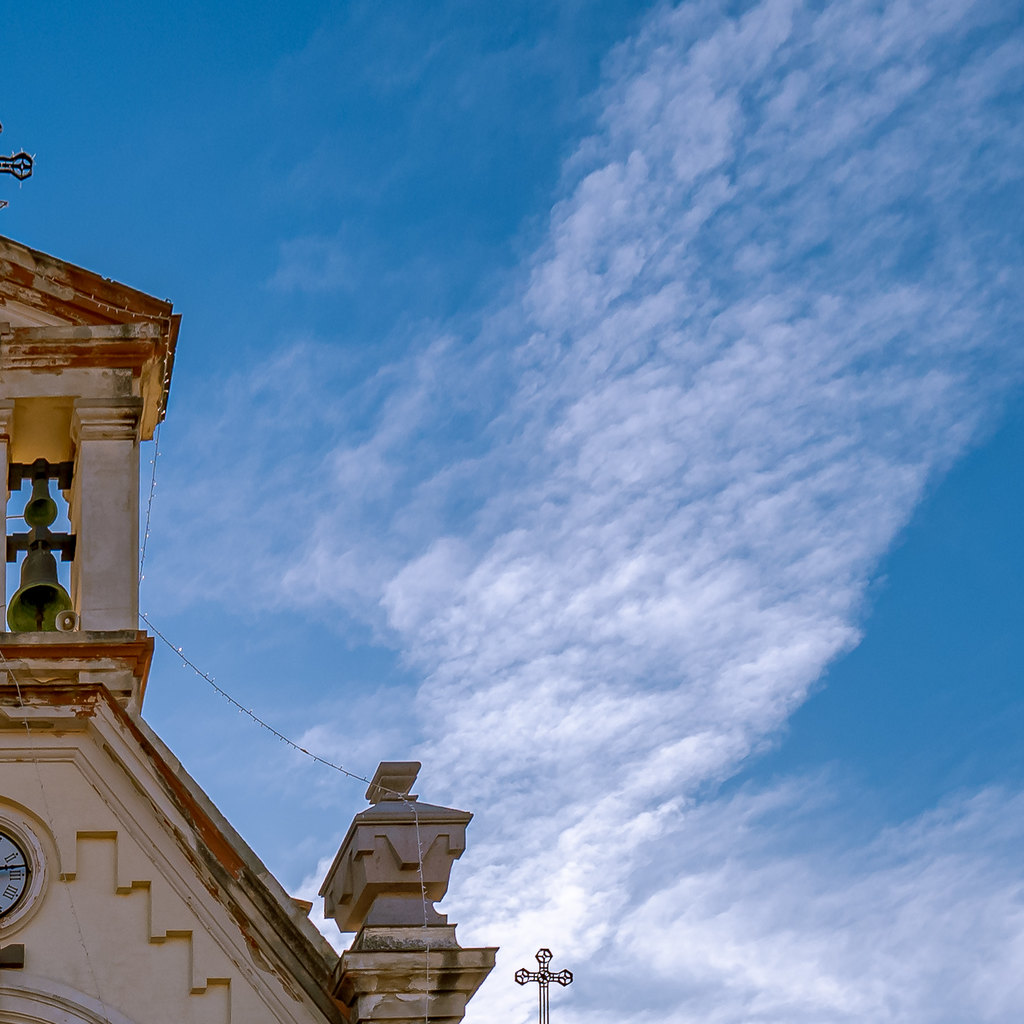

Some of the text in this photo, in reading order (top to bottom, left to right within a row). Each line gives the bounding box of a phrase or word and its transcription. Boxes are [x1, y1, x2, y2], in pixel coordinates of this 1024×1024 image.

[4, 853, 16, 863] II
[10, 870, 21, 880] III
[3, 885, 18, 900] IIII
